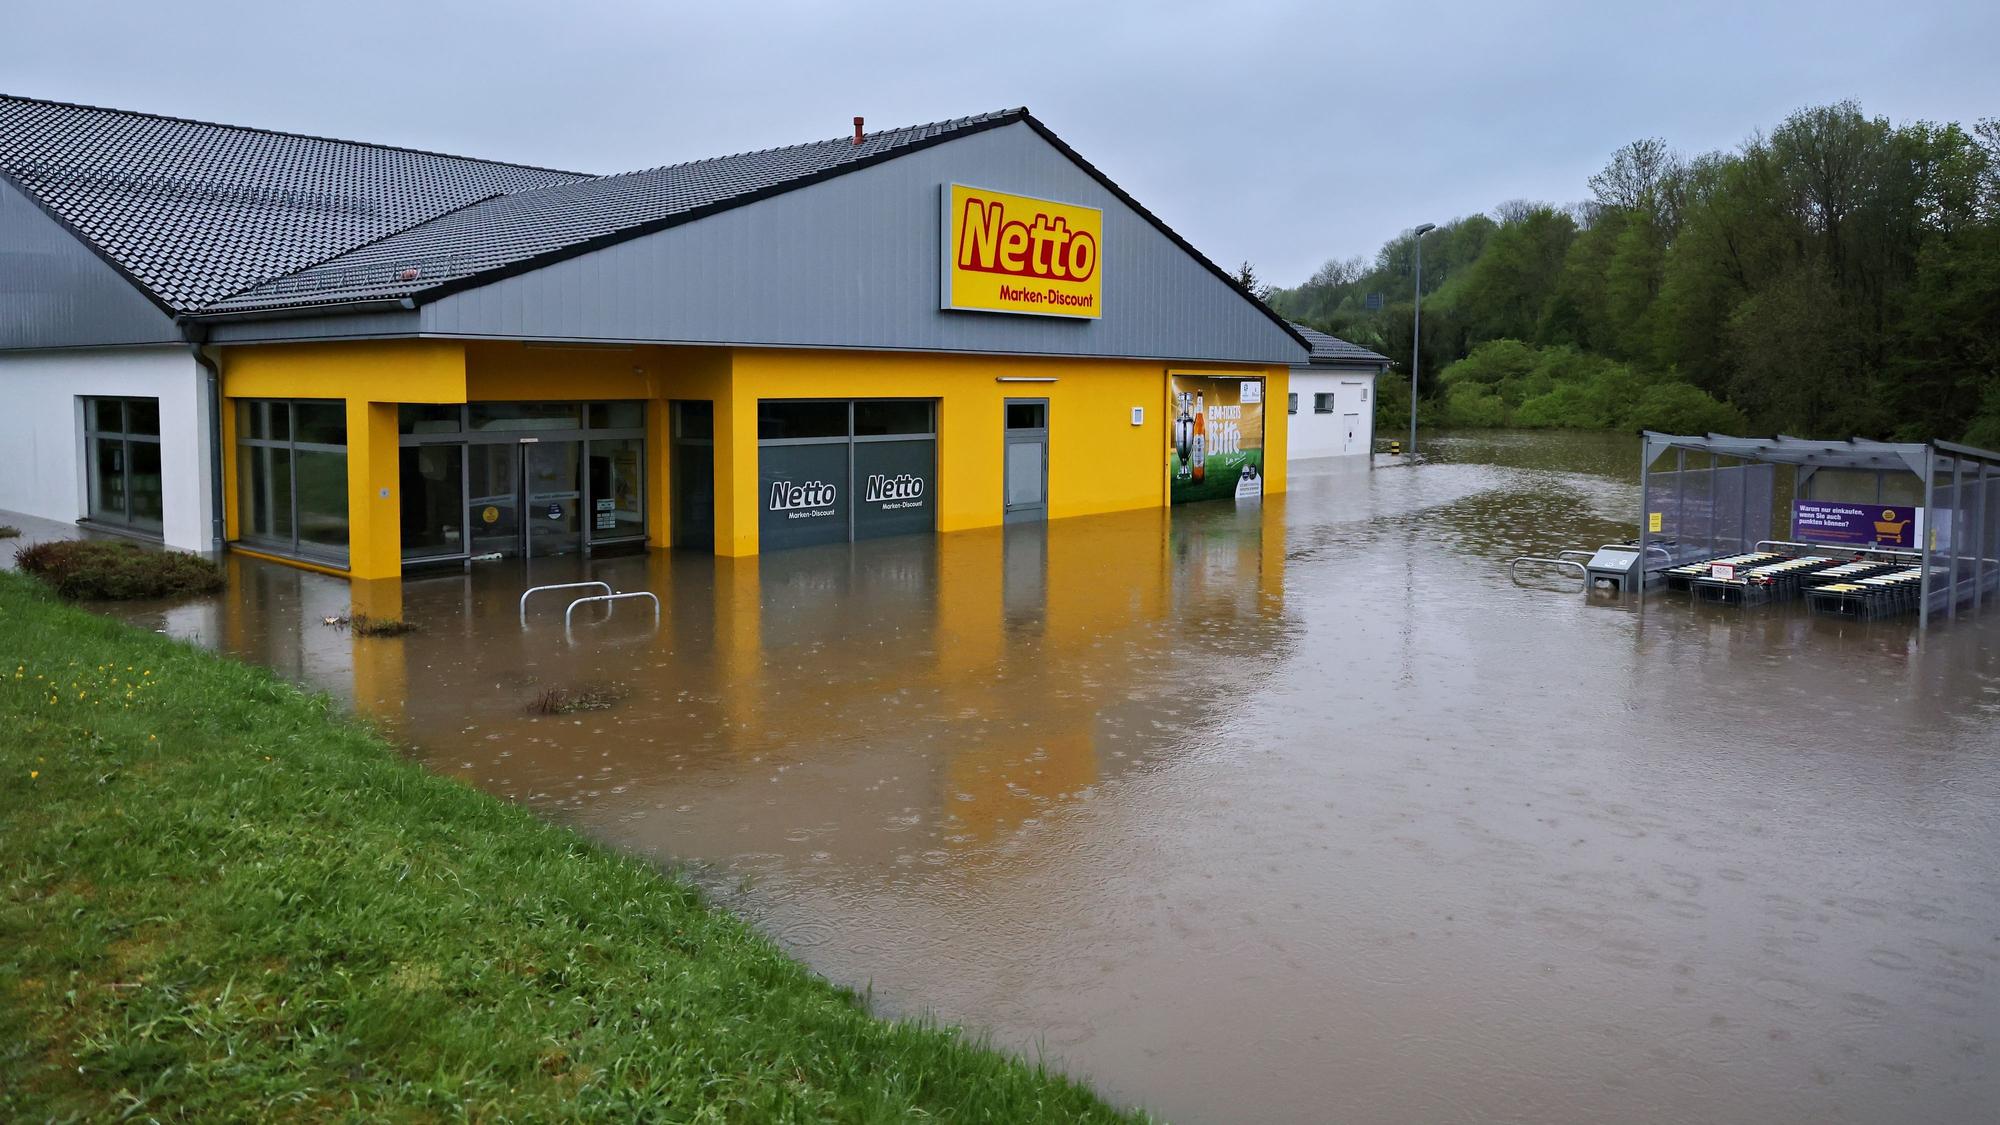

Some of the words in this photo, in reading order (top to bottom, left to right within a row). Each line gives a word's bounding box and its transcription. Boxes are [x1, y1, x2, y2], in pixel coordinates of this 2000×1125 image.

[958, 197, 1096, 282] Netto
[999, 285, 1094, 308] Marken-Discount
[770, 481, 836, 511] Netto
[865, 474, 924, 502] Netto
[788, 510, 835, 519] Marken-Discount
[882, 501, 923, 510] Marken-Discount
[1832, 508, 1864, 516] einkaufen,
